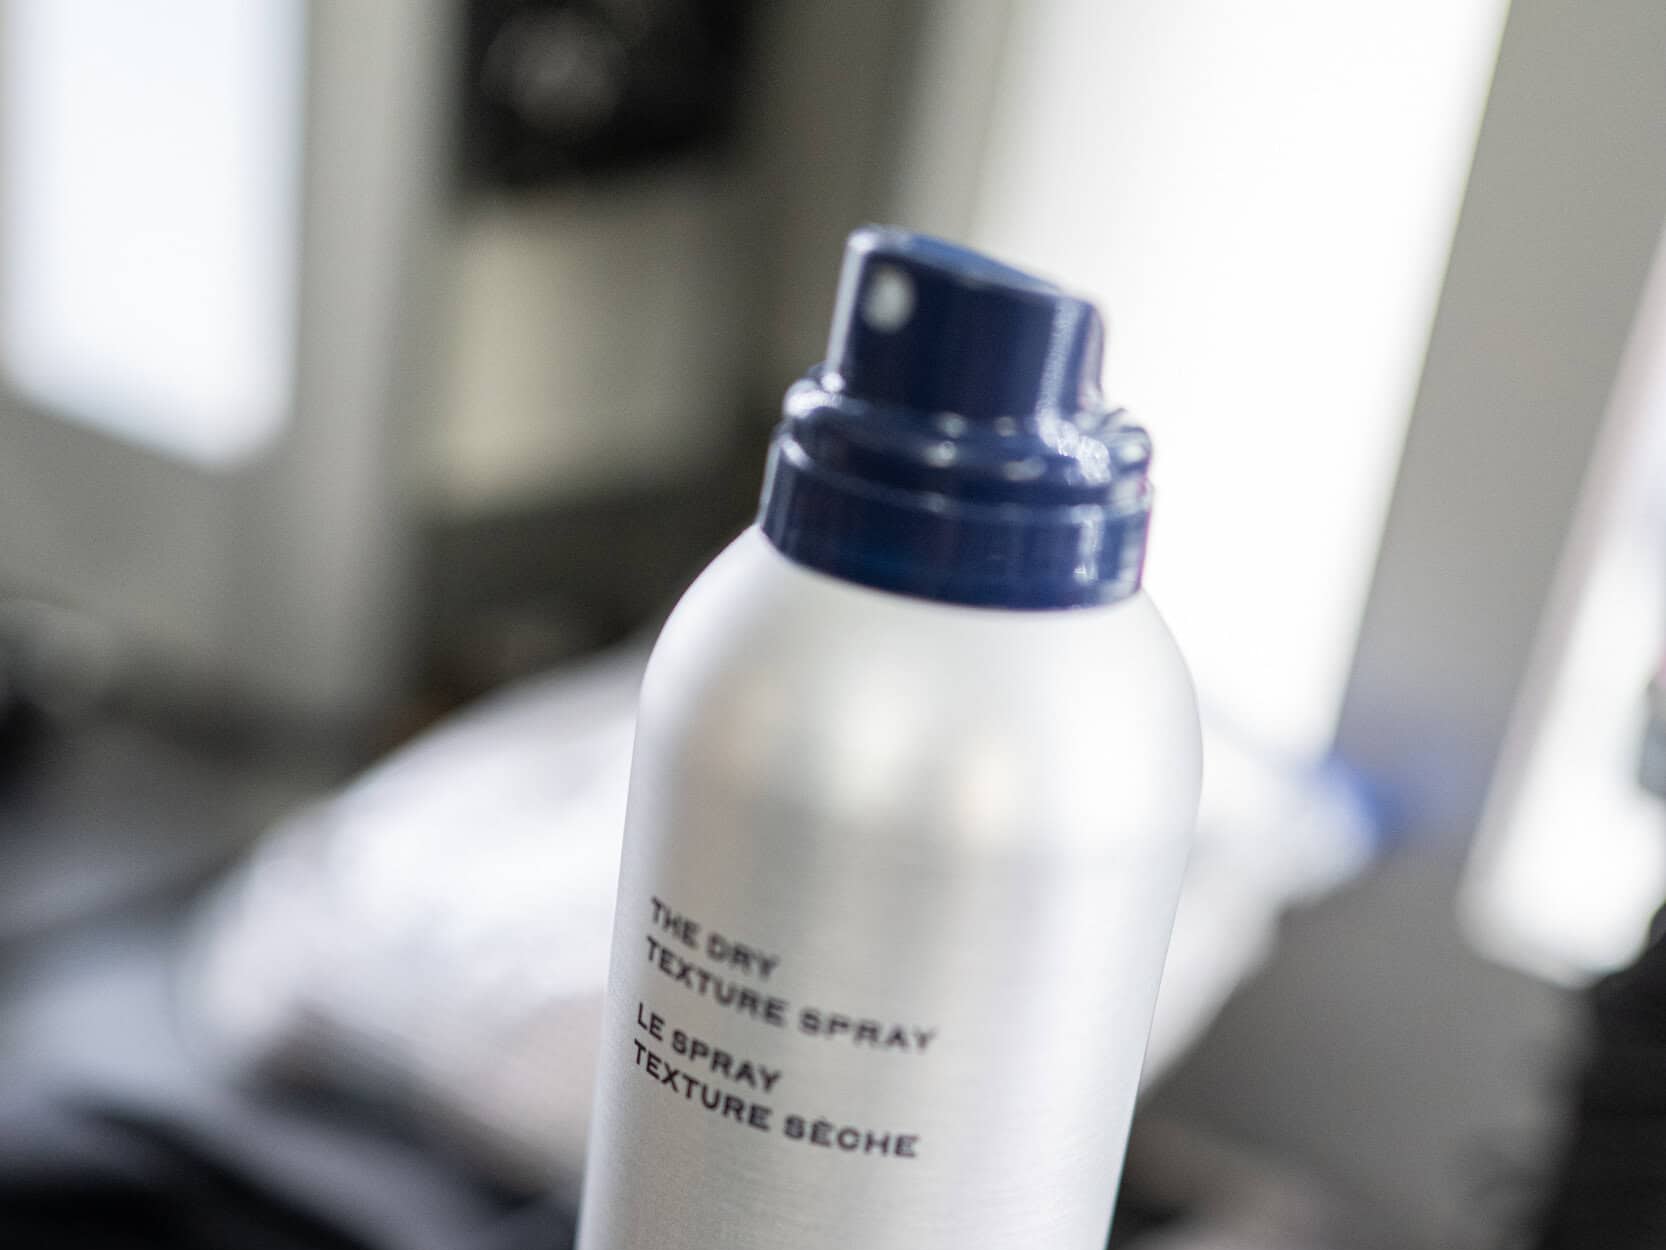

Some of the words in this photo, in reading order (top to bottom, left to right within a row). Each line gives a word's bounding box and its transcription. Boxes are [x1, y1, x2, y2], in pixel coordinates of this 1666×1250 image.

[651, 896, 699, 951] THE
[707, 933, 779, 978] DRY
[647, 936, 788, 1027] TEXTURE
[800, 1007, 935, 1051] SPRAY
[634, 1037, 774, 1132] TEXTURE
[637, 1002, 665, 1041] LE
[671, 1028, 782, 1094] SPRAY
